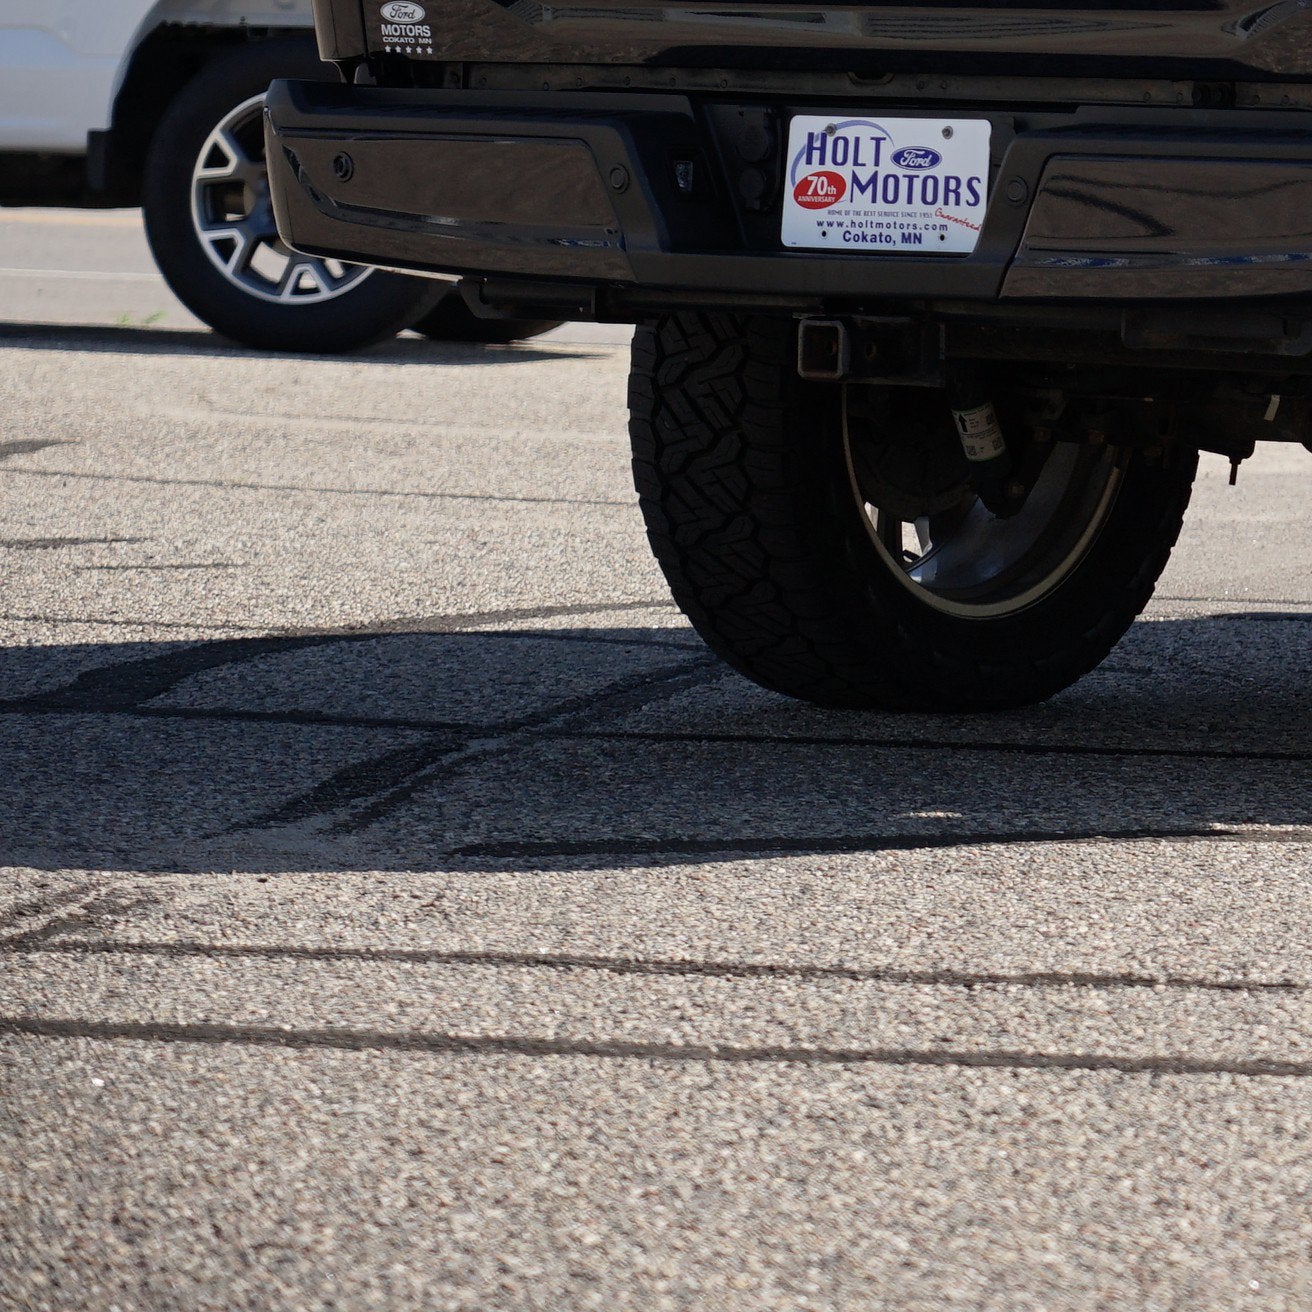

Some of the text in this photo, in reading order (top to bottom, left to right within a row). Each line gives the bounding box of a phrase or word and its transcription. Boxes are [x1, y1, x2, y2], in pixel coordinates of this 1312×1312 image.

[388, 2, 418, 21] Ford
[380, 24, 431, 37] MOTORS
[382, 36, 415, 44] COKATO
[805, 131, 887, 167] HOLT
[898, 147, 932, 169] Ford
[806, 175, 837, 195] 70th
[850, 169, 982, 207] MOTORS
[797, 195, 836, 204] ANNIVERSARY
[816, 218, 949, 232] www.holtmotors.com
[842, 230, 923, 247] Cokato, MN
